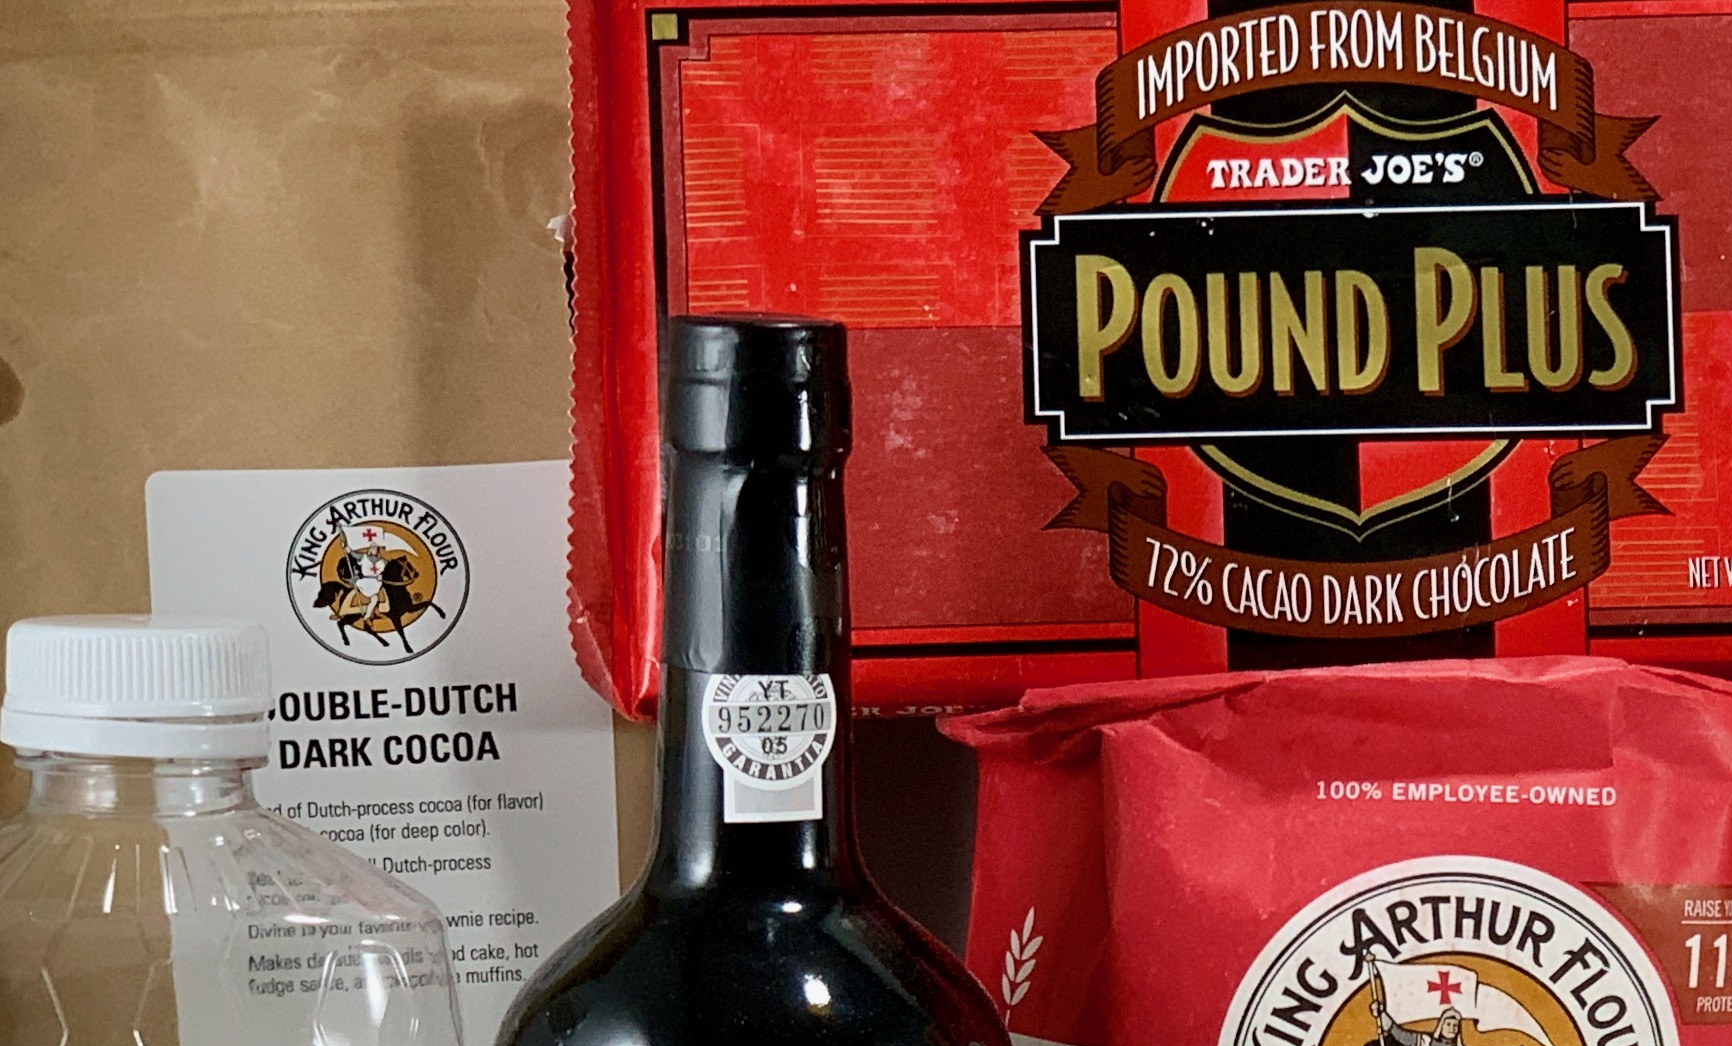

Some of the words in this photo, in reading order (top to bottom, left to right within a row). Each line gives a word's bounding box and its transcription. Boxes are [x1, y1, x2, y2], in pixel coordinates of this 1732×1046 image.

[1138, 10, 1299, 119] IMPORTED
[1311, 9, 1403, 71] FROM
[1416, 12, 1557, 110] BELGIUM
[1207, 156, 1351, 189] TRADER
[1075, 254, 1390, 401] POUND
[1414, 247, 1638, 396] PLUS
[291, 527, 327, 581] KING
[325, 498, 414, 535] ARTHUR
[414, 511, 459, 577] FLOUR
[1146, 537, 1213, 606] 72%
[1223, 562, 1311, 624] CACAO
[1323, 573, 1404, 625] DARK
[1412, 527, 1577, 620] CHOCOLATE
[1688, 556, 1720, 588] NET
[268, 682, 517, 722] OUBLE-DUTCH
[718, 702, 826, 734] 952270
[279, 737, 372, 769] DARK
[383, 731, 500, 763] COCOA
[721, 737, 824, 780] GARANTIA
[287, 803, 302, 819] of
[307, 799, 415, 823] Dutch-process
[419, 799, 462, 813] cocoa
[467, 795, 492, 814] (for
[1316, 780, 1382, 800] 100%
[1392, 782, 1617, 806] EMPLOYEE-OWNED
[1339, 895, 1556, 981] ARTHUR
